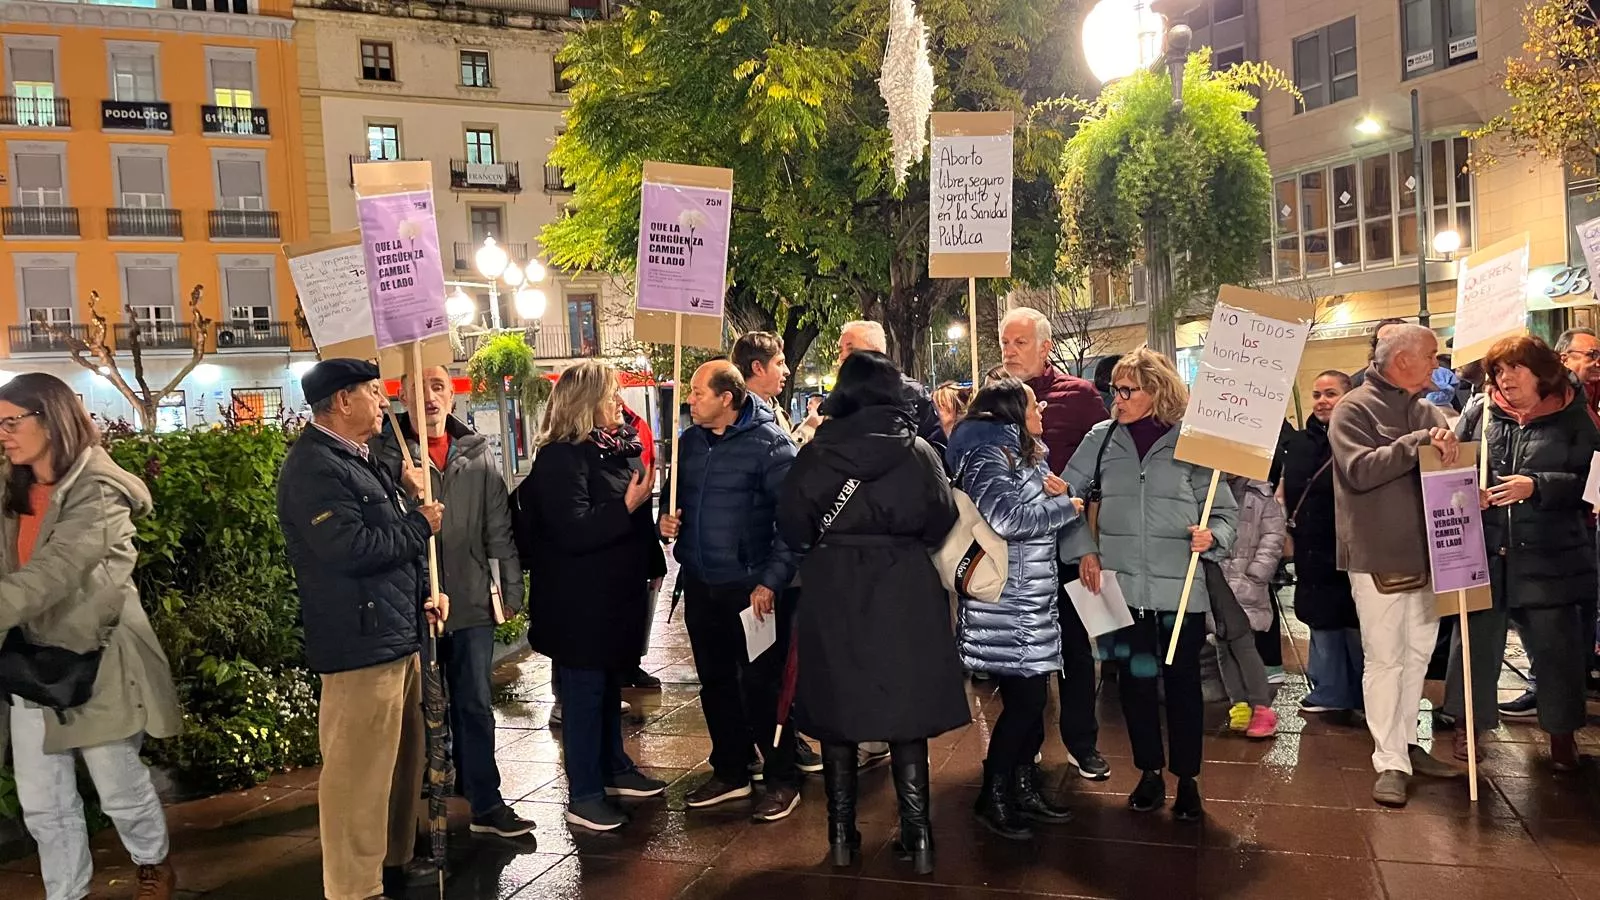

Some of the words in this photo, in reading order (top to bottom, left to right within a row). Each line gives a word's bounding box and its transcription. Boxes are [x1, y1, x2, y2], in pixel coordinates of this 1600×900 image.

[105, 107, 168, 121] PODÓLOGO
[941, 144, 983, 166] Aborto
[970, 176, 1005, 195] seguro
[706, 198, 722, 207] 25N
[946, 183, 988, 210] gratuito
[994, 192, 1001, 210] y
[938, 211, 951, 221] en
[956, 202, 968, 221] la
[970, 202, 1008, 220] Sanidad
[651, 222, 667, 231] QUE
[670, 224, 680, 232] LA
[939, 224, 983, 246] Pública
[375, 241, 391, 253] QUE
[393, 240, 402, 250] LA
[649, 244, 684, 255] CAMBIE
[649, 255, 659, 264] DE
[661, 257, 685, 266] LADO
[379, 264, 410, 279] CAMBIE
[380, 280, 391, 291] DE
[392, 277, 413, 290] LADO
[1220, 312, 1238, 326] NO
[1250, 319, 1295, 339] TODOS
[1242, 332, 1260, 349] los
[1202, 371, 1236, 386] Pero
[1244, 380, 1285, 402] todos
[1218, 392, 1248, 407] son
[1198, 399, 1263, 429] hombres
[1433, 508, 1445, 518] QUE
[1447, 507, 1455, 515] LA
[1435, 528, 1460, 538] CAMBIE
[1436, 540, 1445, 549] DE
[1446, 537, 1462, 547] LADO
